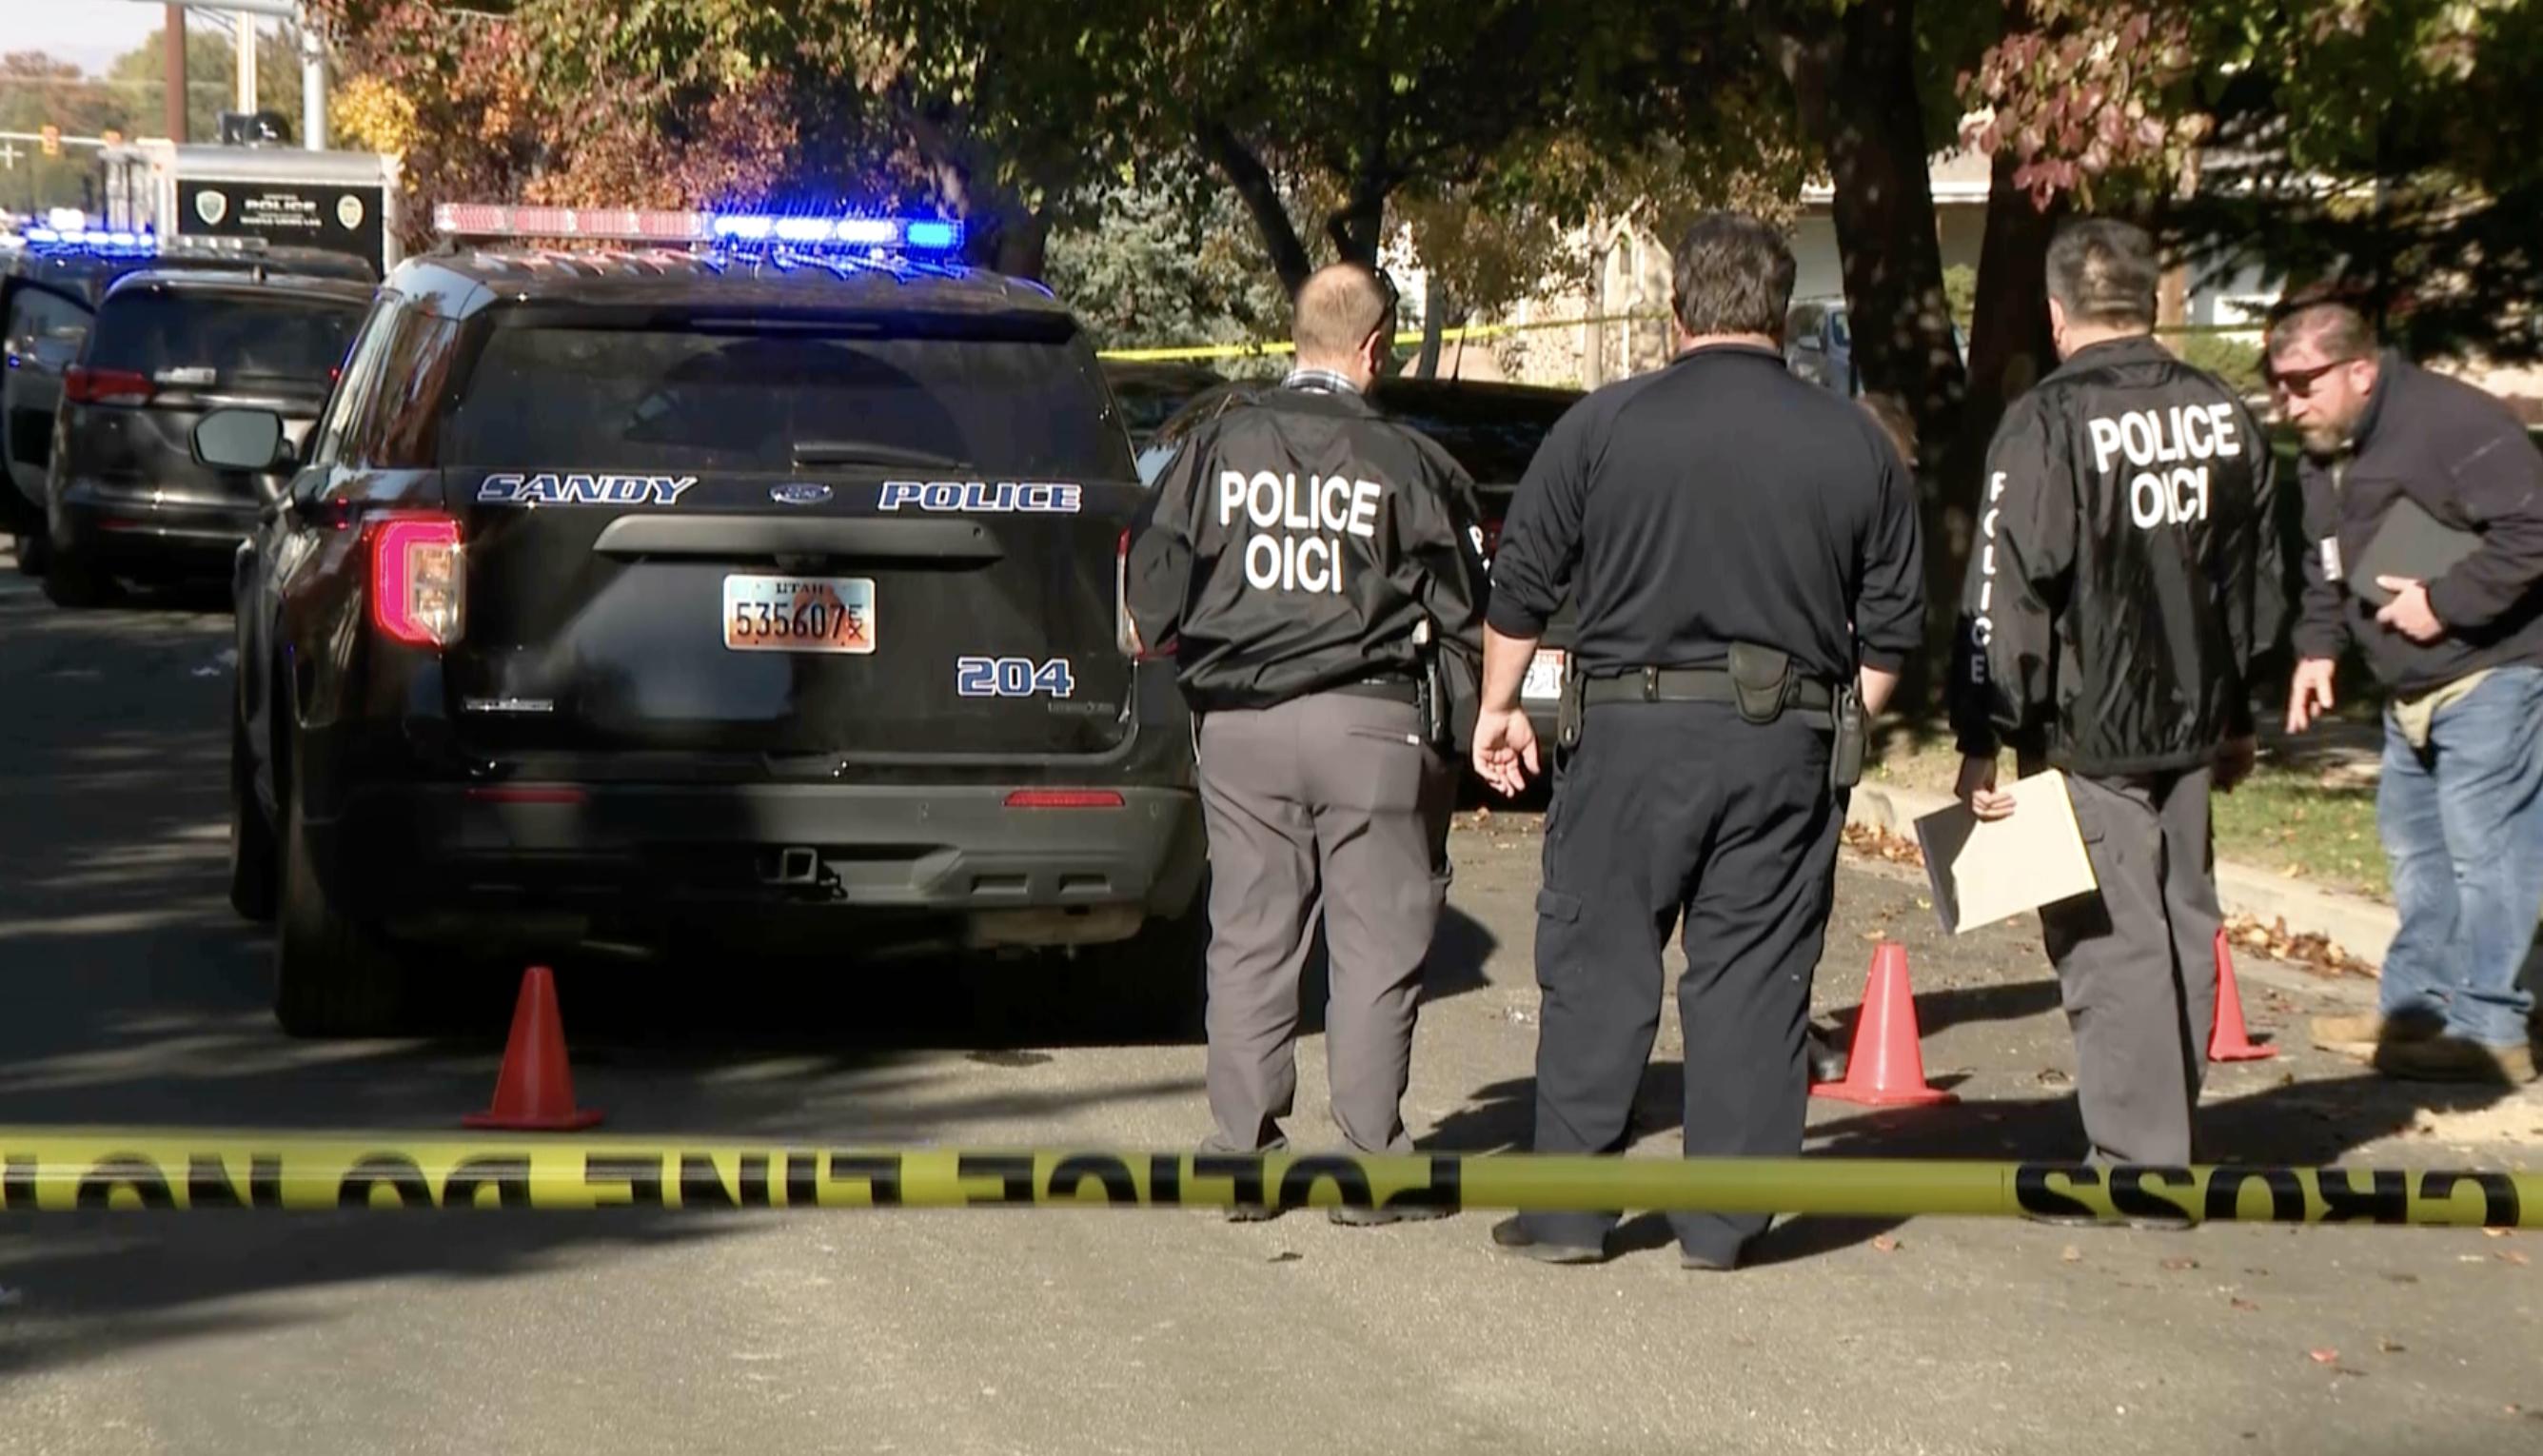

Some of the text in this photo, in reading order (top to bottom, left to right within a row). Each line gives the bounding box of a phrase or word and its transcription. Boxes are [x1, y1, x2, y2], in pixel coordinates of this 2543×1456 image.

[244, 199, 317, 211] POLICE
[2088, 403, 2240, 473] POLICE
[477, 473, 699, 504] SANDY
[877, 482, 1082, 513] POLICE
[1219, 470, 1381, 538] POLICE
[2130, 466, 2208, 528] OICI
[1245, 533, 1343, 594] OICI
[776, 582, 823, 595] UTAH
[736, 601, 846, 639] 535607
[957, 657, 1074, 698] 204
[2016, 1164, 2519, 1227] CROSS
